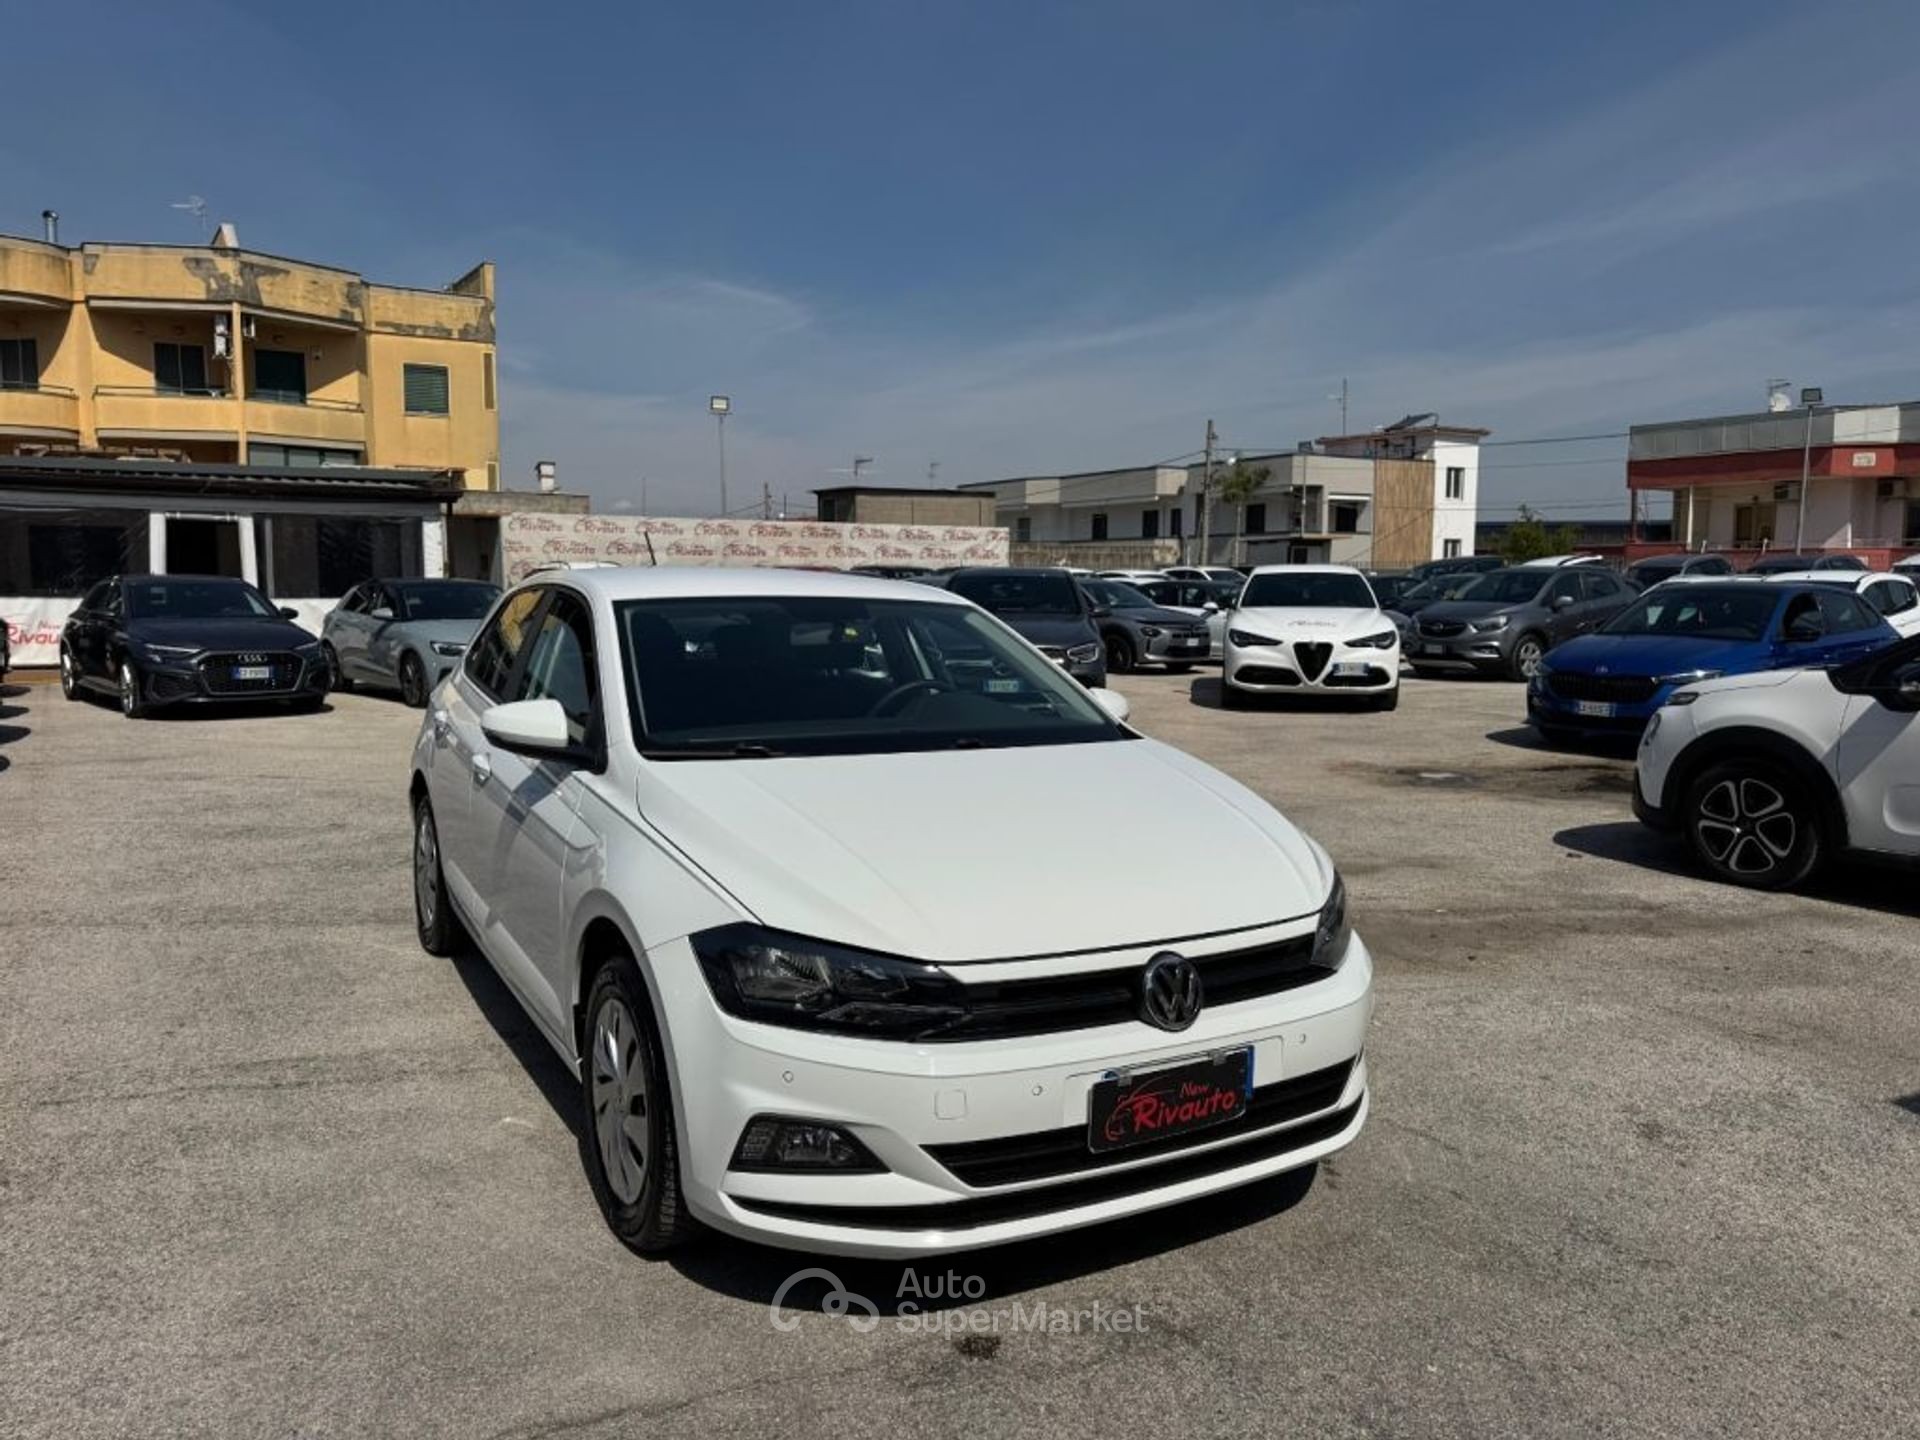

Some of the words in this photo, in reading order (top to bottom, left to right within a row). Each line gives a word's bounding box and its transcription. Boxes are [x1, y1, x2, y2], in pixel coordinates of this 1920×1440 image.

[5, 623, 60, 645] Rivau
[1179, 1081, 1209, 1099] New
[1132, 1090, 1236, 1133] Rivauto
